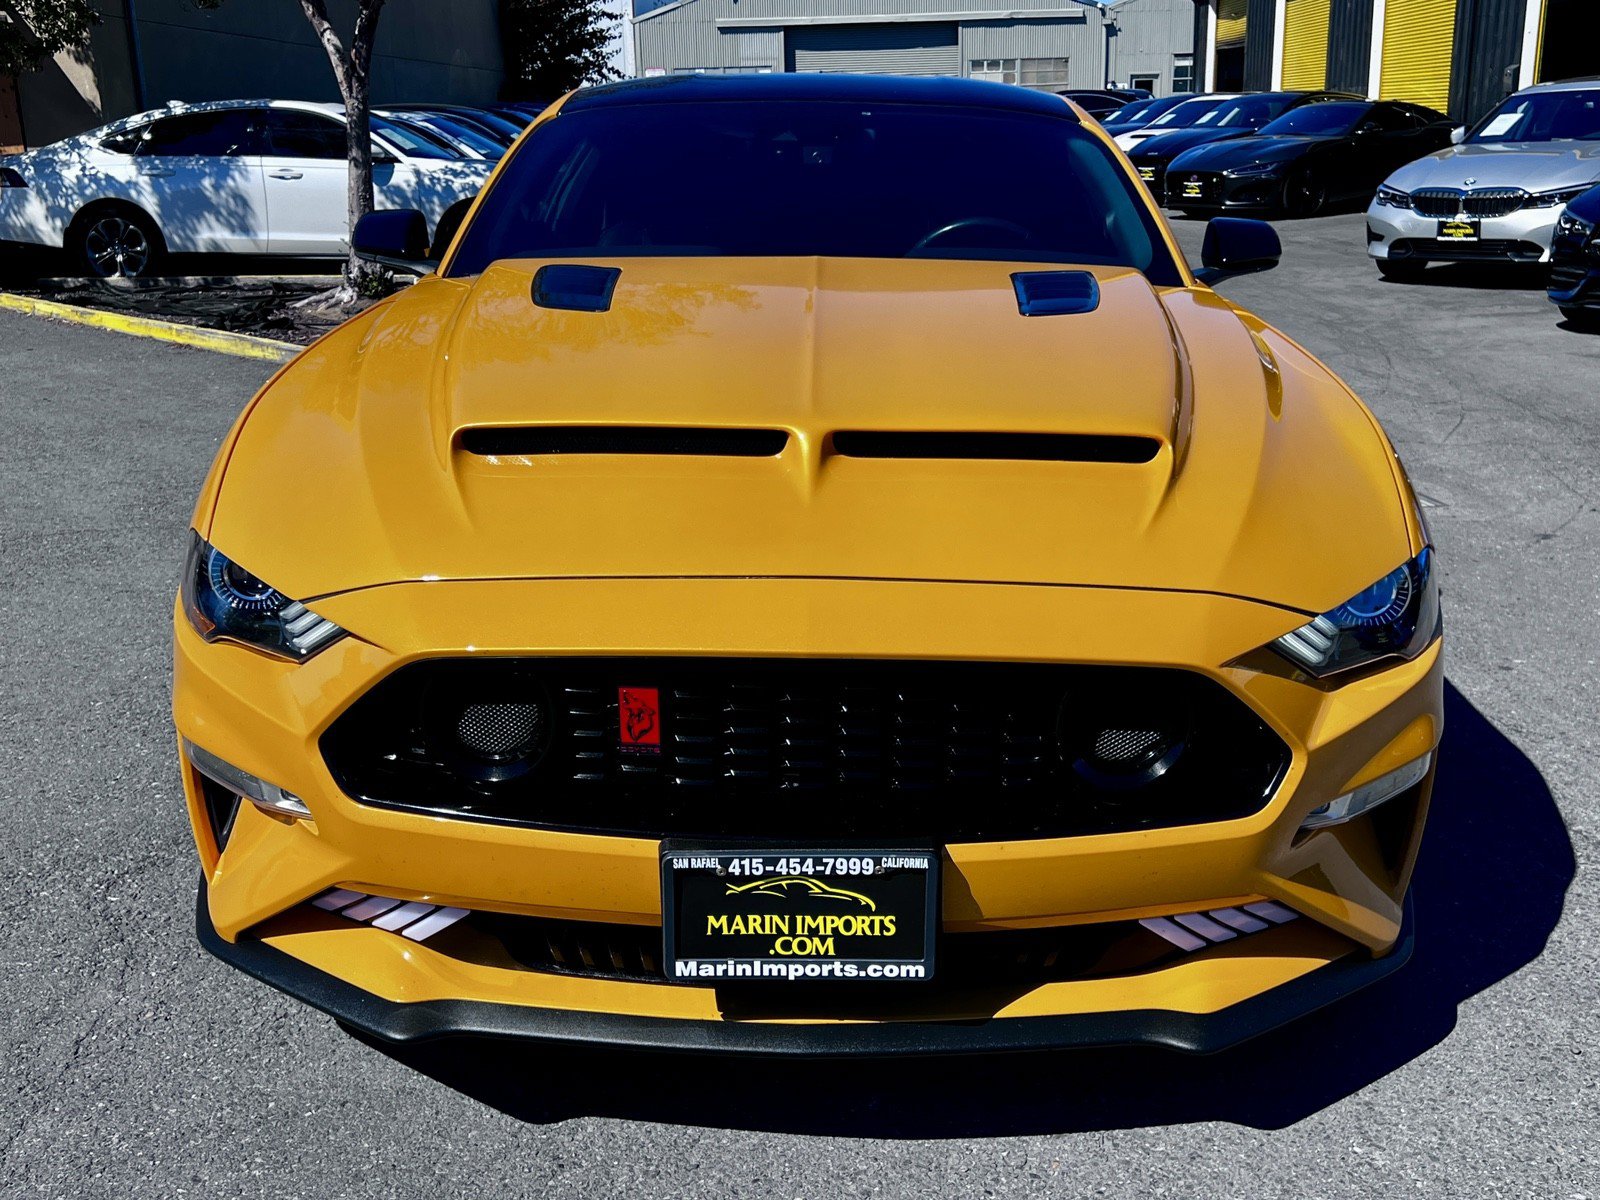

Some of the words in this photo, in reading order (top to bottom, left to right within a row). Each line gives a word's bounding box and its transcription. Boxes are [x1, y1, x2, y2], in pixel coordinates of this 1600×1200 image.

[672, 858, 689, 869] SAN
[690, 857, 721, 869] RAFAEL
[728, 857, 874, 876] 415-454-7999
[881, 857, 929, 869] CALIFORNIA
[706, 914, 790, 936] MARIN
[795, 915, 896, 936] IMPORTS
[769, 936, 836, 956] .COM
[674, 959, 925, 980] MarinImports.com
